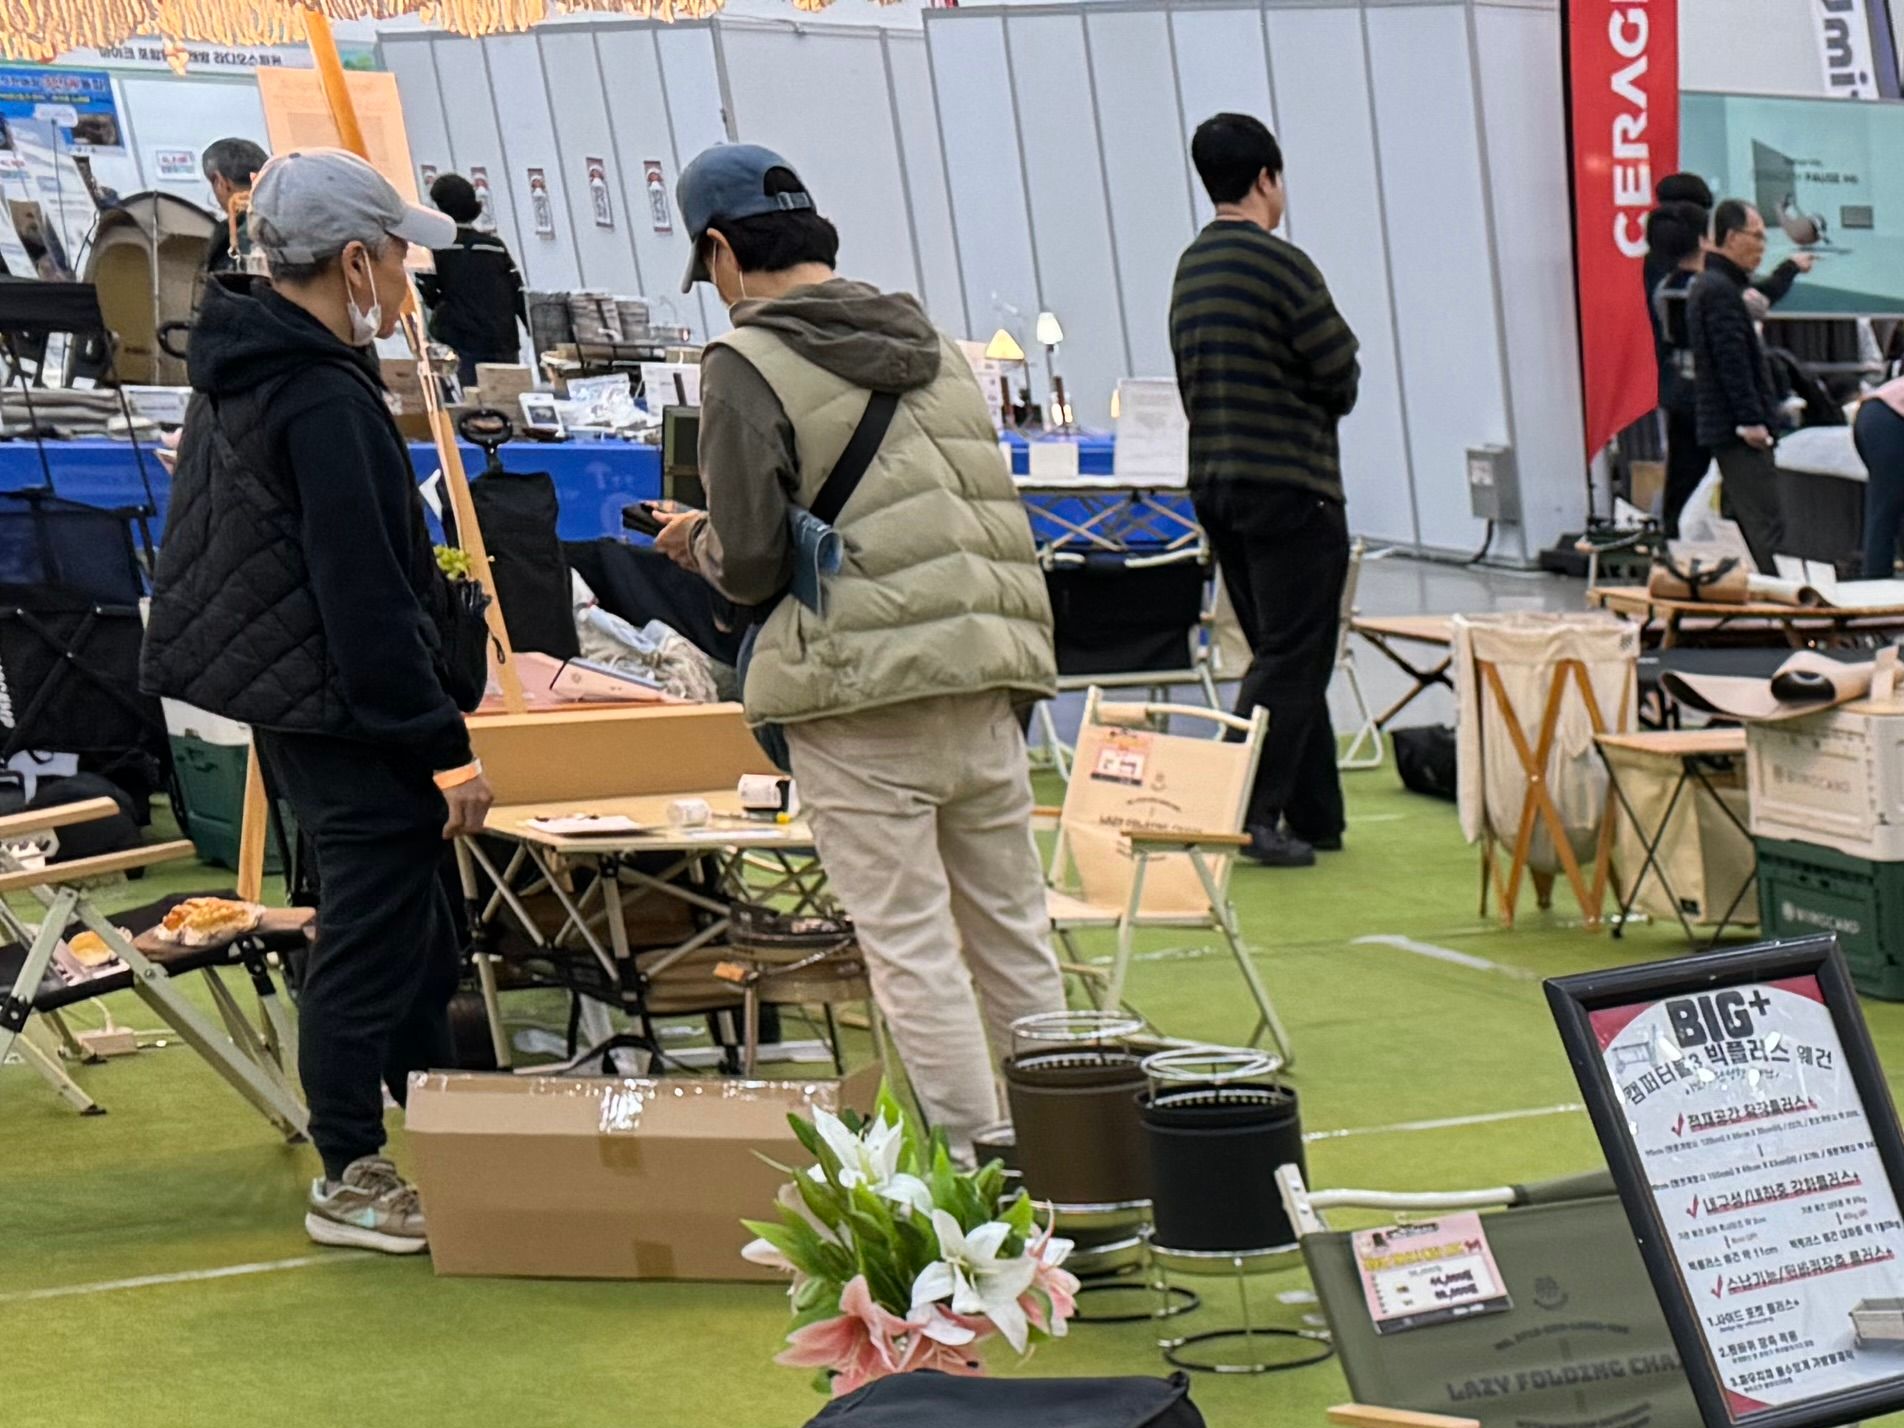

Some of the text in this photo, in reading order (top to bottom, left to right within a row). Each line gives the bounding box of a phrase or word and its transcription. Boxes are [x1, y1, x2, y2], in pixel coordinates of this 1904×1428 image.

[1608, 0, 1652, 259] CERAG
[1665, 990, 1772, 1049] BIG+
[1703, 1038, 1790, 1068] 빅플러스
[1795, 1044, 1833, 1071] 웨건
[1446, 1349, 1684, 1402] LAZY FOLDING CHA
